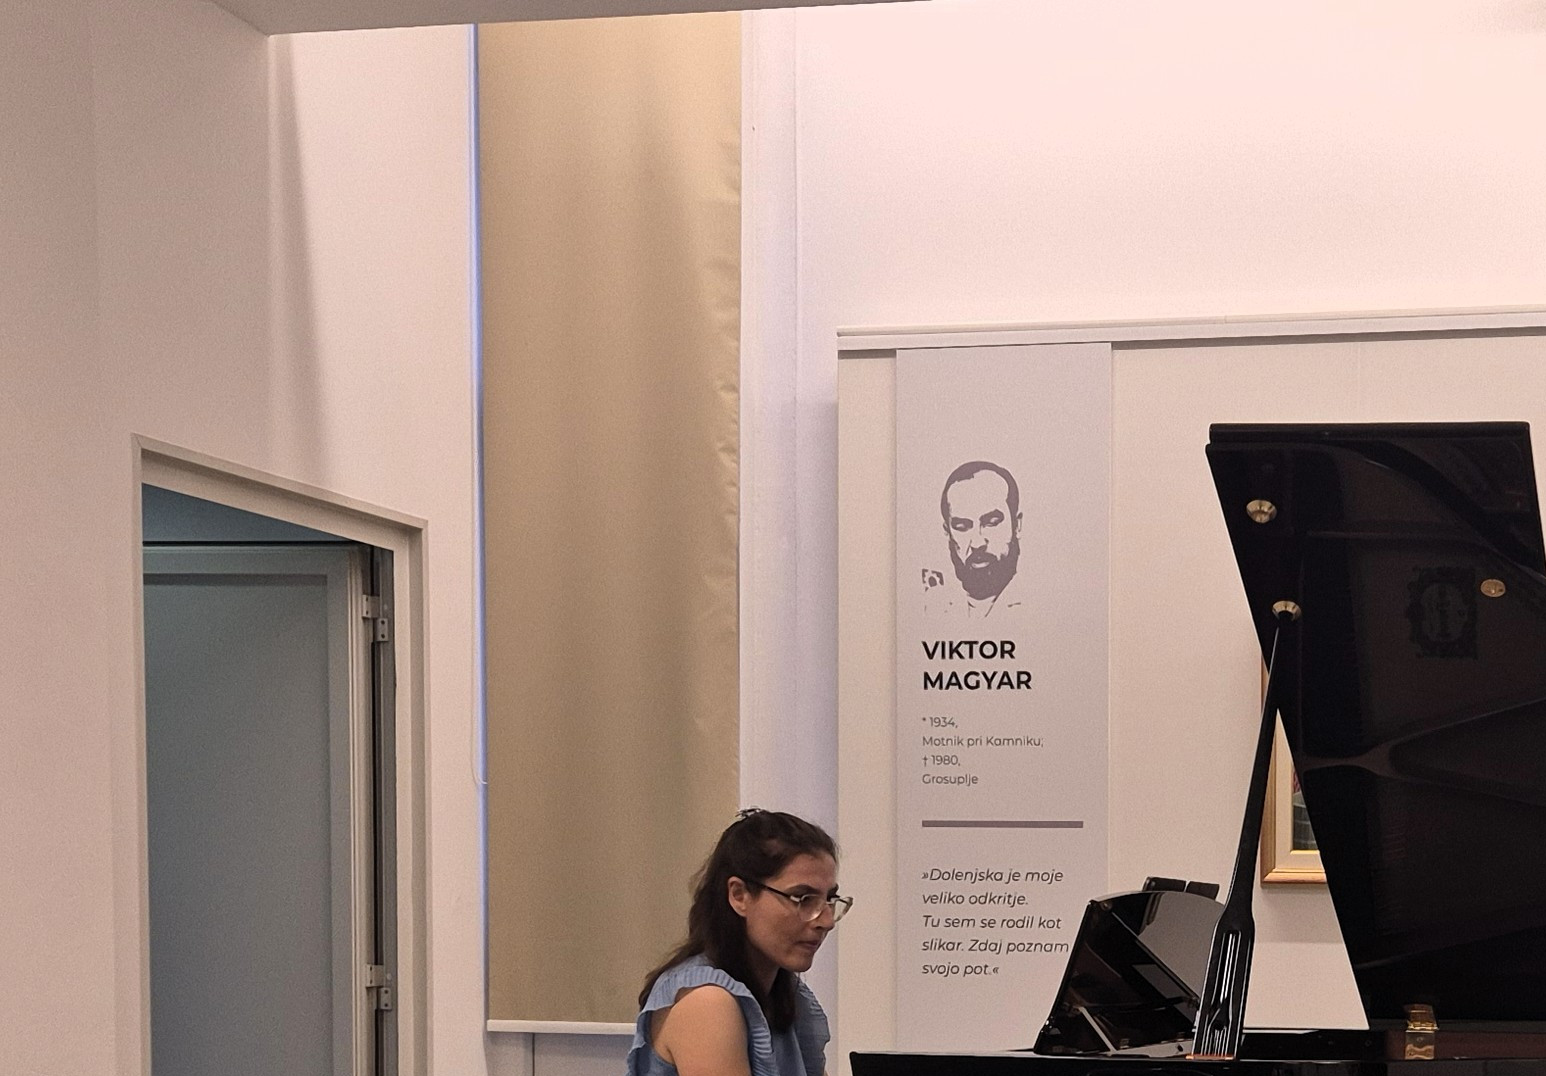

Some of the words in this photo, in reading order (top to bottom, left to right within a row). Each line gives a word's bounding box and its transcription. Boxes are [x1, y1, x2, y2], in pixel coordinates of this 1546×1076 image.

[921, 640, 1016, 660] VIKTOR
[922, 671, 1033, 690] MAGYAR
[929, 716, 958, 729] 1934,
[922, 736, 964, 747] Motnik
[967, 736, 983, 748] pri
[931, 754, 961, 767] 1980,
[922, 773, 979, 787] Grosuplje
[1004, 868, 1021, 885] je
[1025, 869, 1064, 885] moje
[922, 891, 965, 905] veliko
[968, 892, 1029, 908] odkritje.
[922, 914, 941, 928] Tu
[944, 917, 976, 928] sem
[980, 918, 997, 929] se
[1000, 915, 1034, 929] rodil
[1038, 916, 1062, 929] kot
[921, 938, 964, 952] slikar.
[968, 939, 1002, 955] Zdaj
[1006, 942, 1069, 955] poznam
[921, 962, 960, 977] svojo
